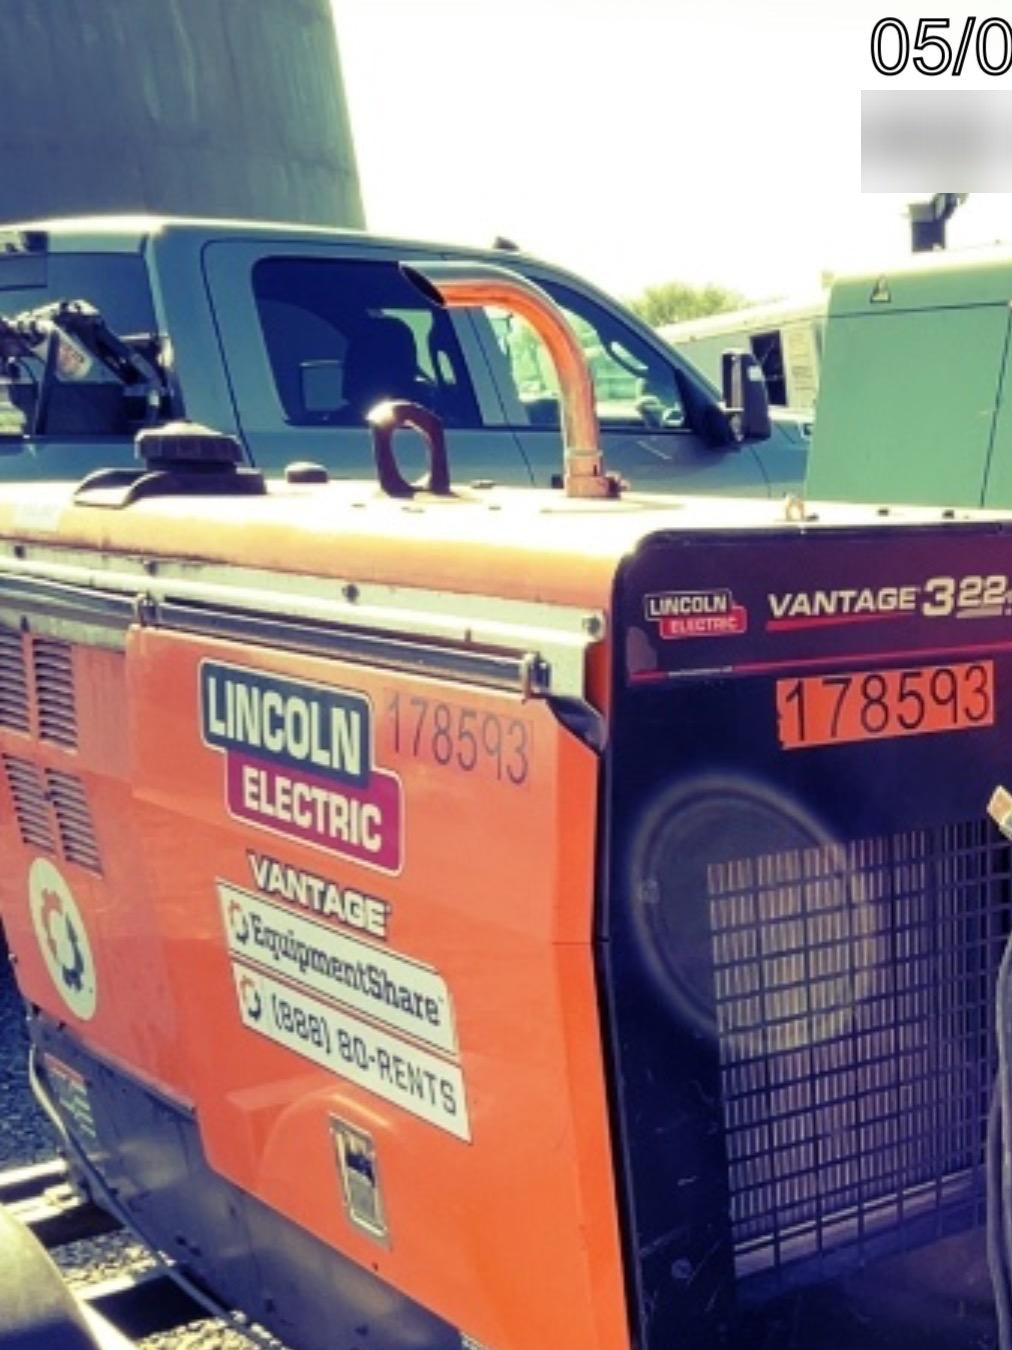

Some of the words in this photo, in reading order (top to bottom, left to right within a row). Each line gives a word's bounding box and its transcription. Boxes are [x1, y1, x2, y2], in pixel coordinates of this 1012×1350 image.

[650, 593, 727, 617] LINCOLN
[670, 616, 739, 634] ELECTRIC
[767, 587, 917, 619] VANTAGE
[922, 575, 1008, 617] 322
[207, 675, 361, 775] LINCOLN
[384, 690, 529, 785] 178593
[785, 664, 990, 742] 178593
[242, 765, 382, 853] ELECTRIC
[247, 849, 391, 941] VANTAGE
[250, 911, 441, 1026] EquipmentShare
[271, 993, 331, 1054] (888)
[337, 1028, 457, 1116] 80-RENTS
